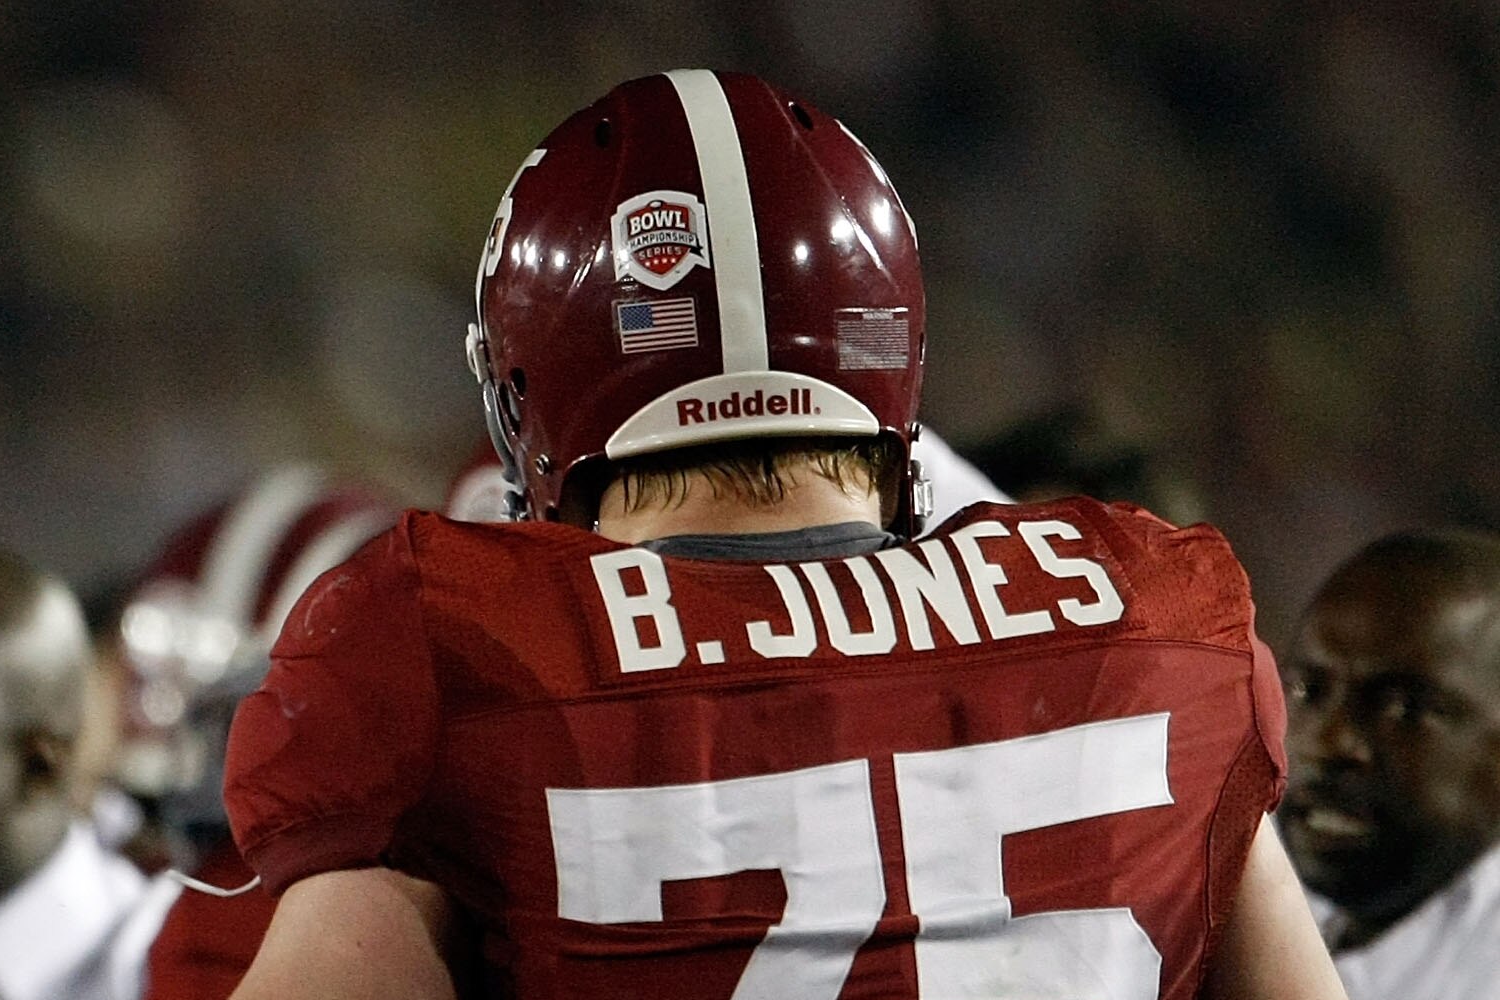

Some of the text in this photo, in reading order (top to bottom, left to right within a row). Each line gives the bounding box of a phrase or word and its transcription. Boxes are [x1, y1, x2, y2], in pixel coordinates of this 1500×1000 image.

[629, 210, 686, 236] BOWL
[627, 231, 695, 249] HAMPIONSHIP
[638, 246, 682, 260] SERIES
[590, 520, 1124, 673] B. JONES
